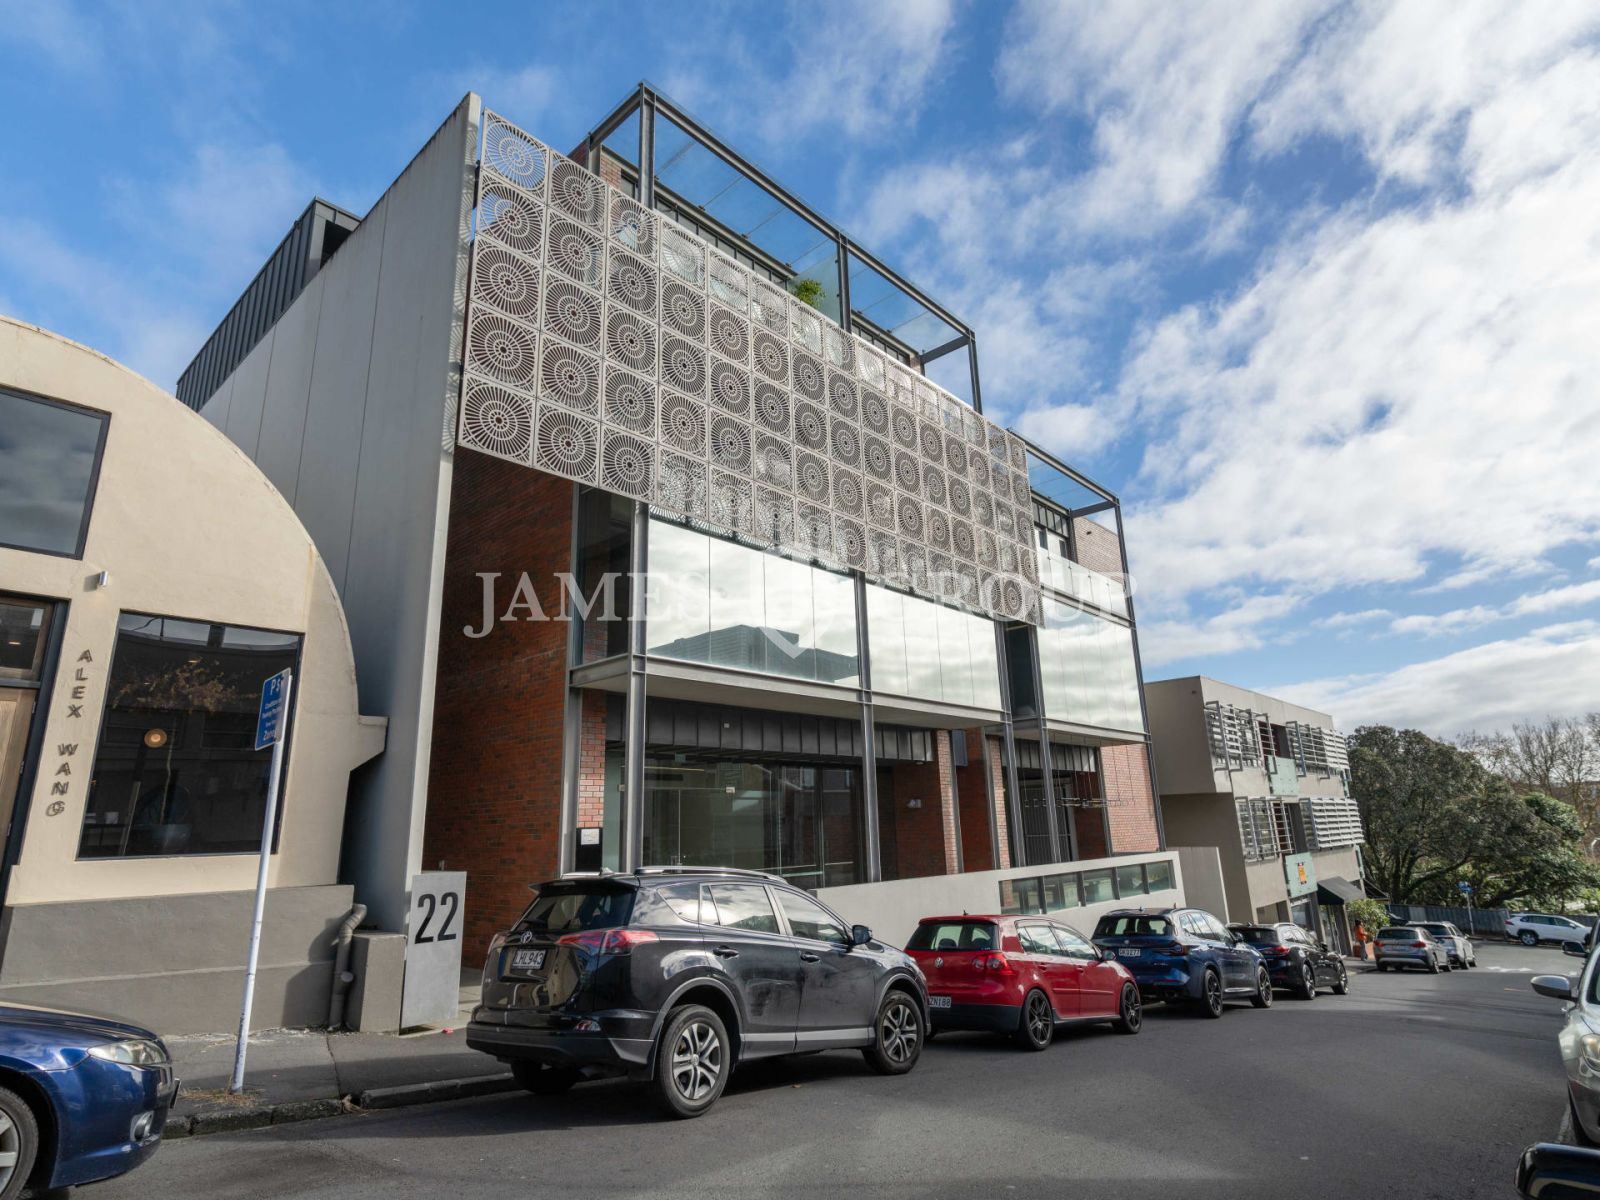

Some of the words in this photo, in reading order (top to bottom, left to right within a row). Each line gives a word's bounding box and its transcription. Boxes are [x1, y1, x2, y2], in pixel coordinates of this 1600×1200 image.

[66, 648, 93, 719] ALEX
[45, 743, 79, 818] WANG
[414, 891, 459, 945] 22
